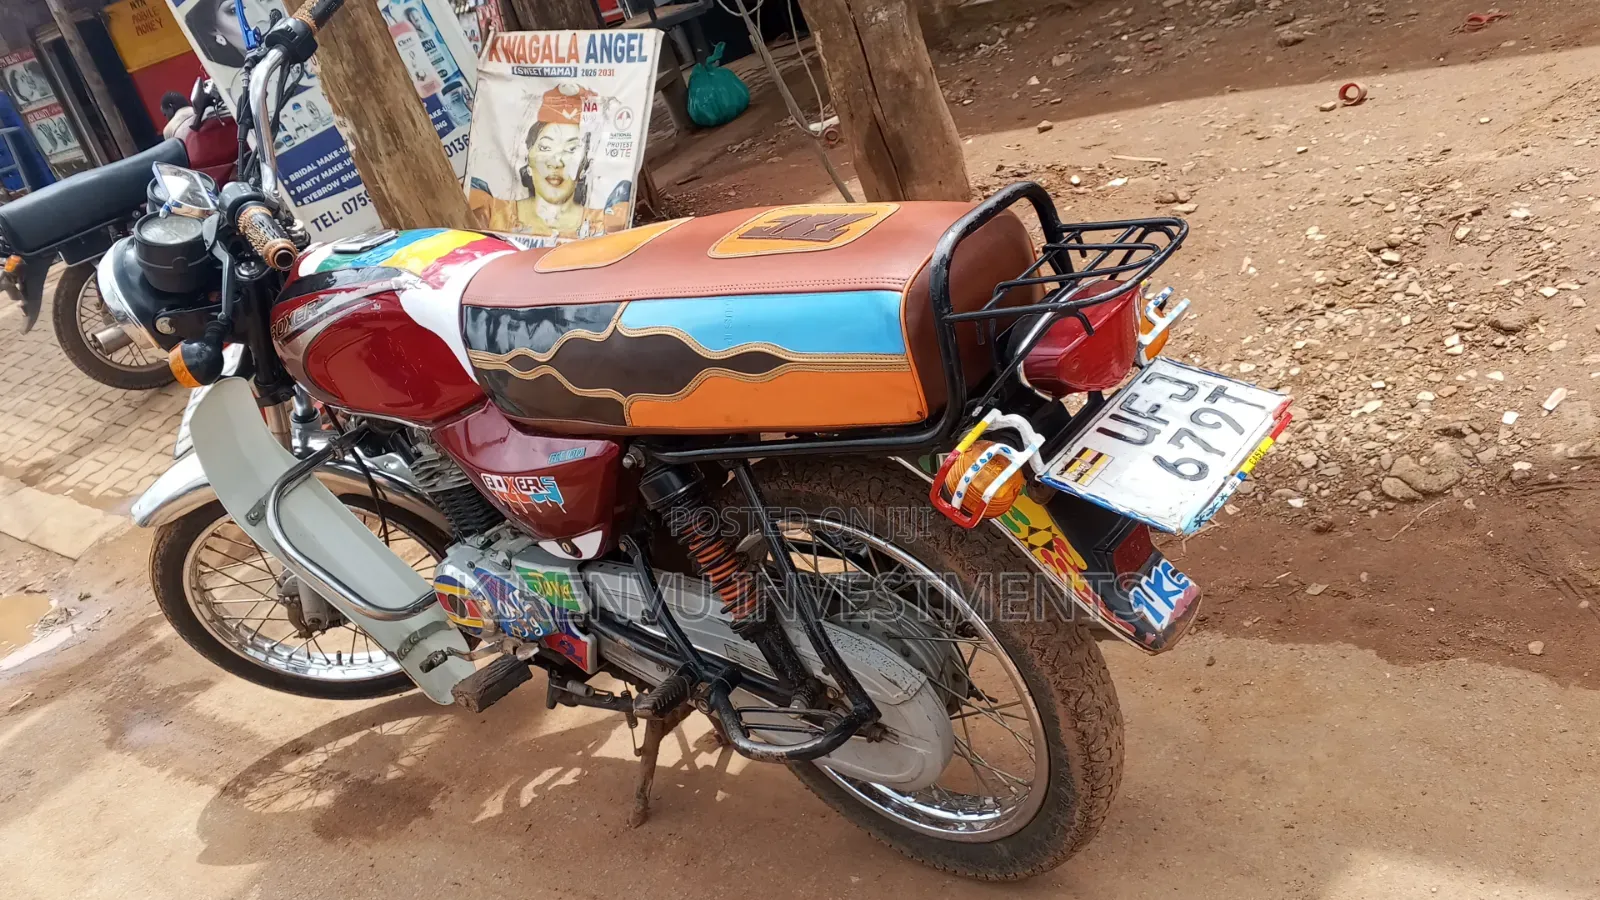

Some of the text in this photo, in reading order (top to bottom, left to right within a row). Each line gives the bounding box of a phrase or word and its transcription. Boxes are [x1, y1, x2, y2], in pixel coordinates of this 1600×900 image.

[135, 17, 164, 36] MONEY
[488, 33, 648, 64] KWAGALA ANGEL
[581, 68, 597, 77] 2026
[598, 68, 615, 77] 2031
[289, 144, 349, 182] BRIDAL MAKE-U
[605, 148, 632, 157] VOTE
[296, 174, 321, 193] PARTY
[302, 178, 340, 205] EYEBROW
[311, 210, 344, 232] TEL:
[270, 299, 319, 341] BOXER
[1096, 371, 1200, 446] UFJ
[1153, 384, 1266, 482] 679T
[1249, 449, 1265, 466] EASY
